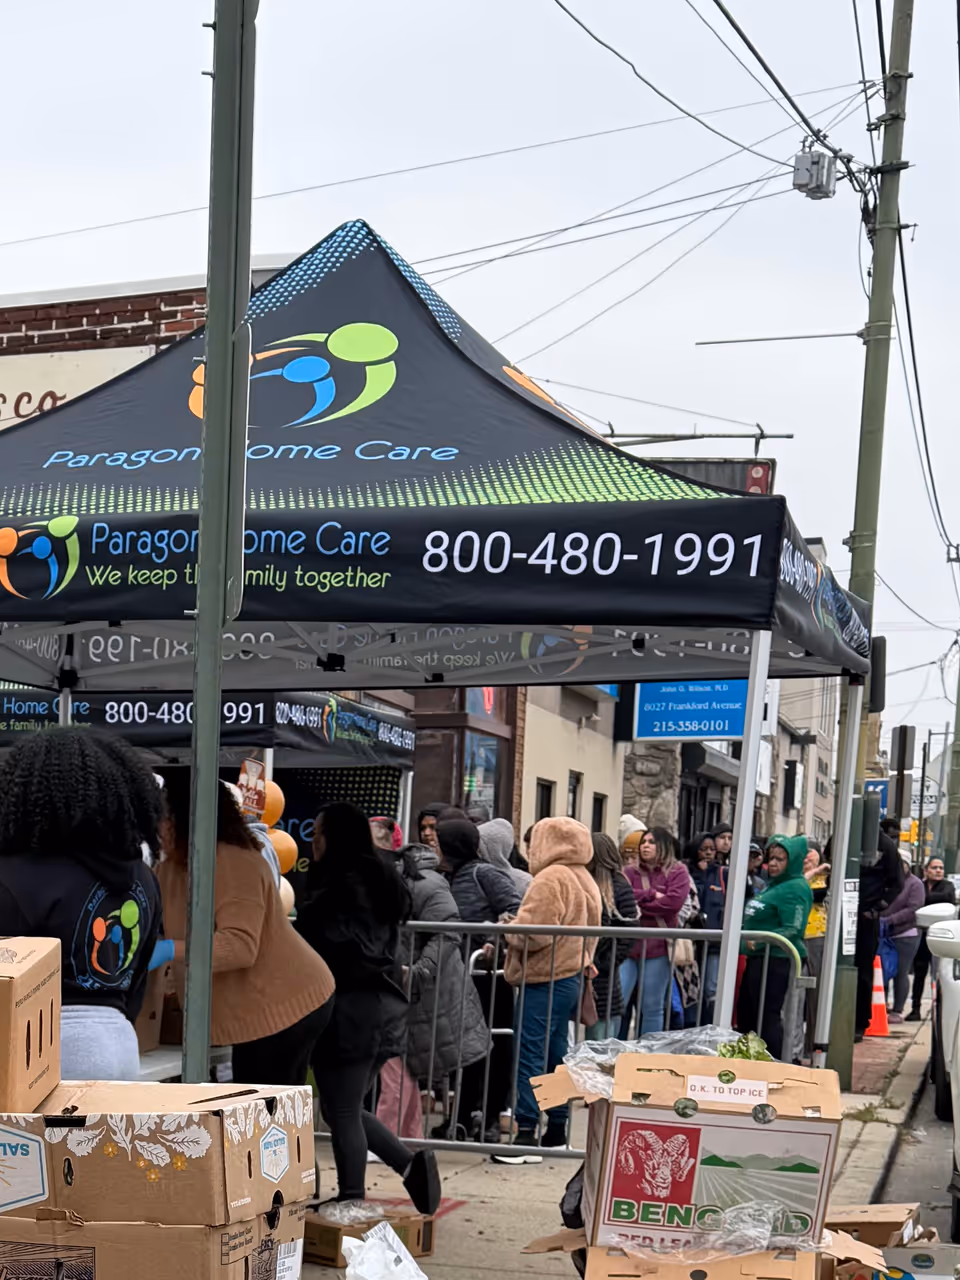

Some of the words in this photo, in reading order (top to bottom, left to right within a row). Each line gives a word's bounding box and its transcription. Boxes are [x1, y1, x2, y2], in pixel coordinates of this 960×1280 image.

[42, 446, 201, 470] Paragon
[246, 441, 341, 461] ome
[355, 440, 460, 462] Care
[243, 528, 306, 556] ome
[315, 521, 391, 556] Care
[422, 529, 764, 579] 800-480-1991
[85, 565, 121, 587] We
[128, 563, 177, 590] keep
[245, 565, 287, 592] mily
[295, 563, 391, 593] together
[3, 698, 49, 715] Home
[690, 1083, 709, 1094] O.K.
[712, 1085, 725, 1095] TO
[727, 1086, 746, 1097] TOP
[748, 1087, 765, 1098] ICE
[611, 1199, 815, 1235] BENGD
